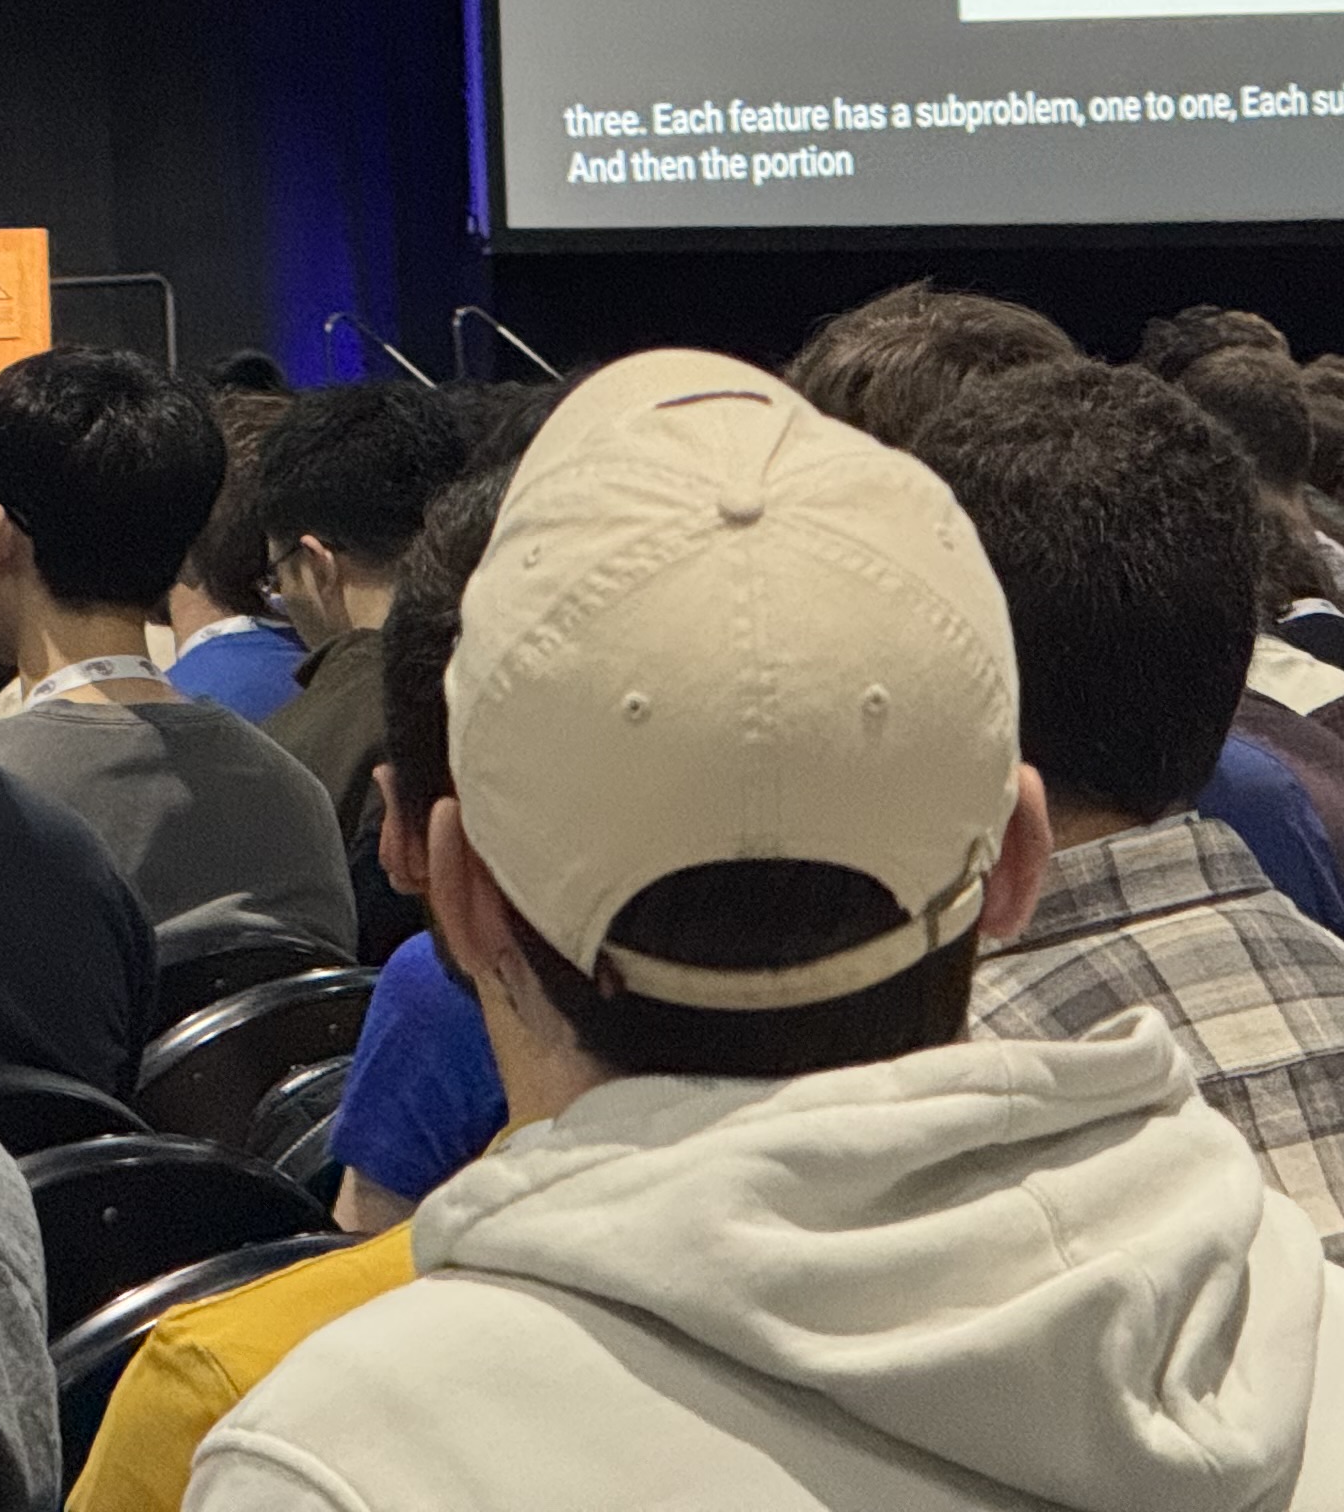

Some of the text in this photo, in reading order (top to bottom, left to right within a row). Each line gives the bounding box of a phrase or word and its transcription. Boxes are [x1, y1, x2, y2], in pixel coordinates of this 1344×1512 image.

[564, 106, 648, 137] three.
[653, 101, 724, 135] Each
[729, 99, 830, 133] feature
[834, 96, 886, 129] has
[892, 103, 911, 128] a
[916, 91, 1085, 133] subproblem,
[1089, 97, 1141, 123] one
[1145, 94, 1173, 120] to
[1179, 94, 1237, 123] one,
[1241, 84, 1308, 117] Each
[567, 145, 854, 185] And then the portion
